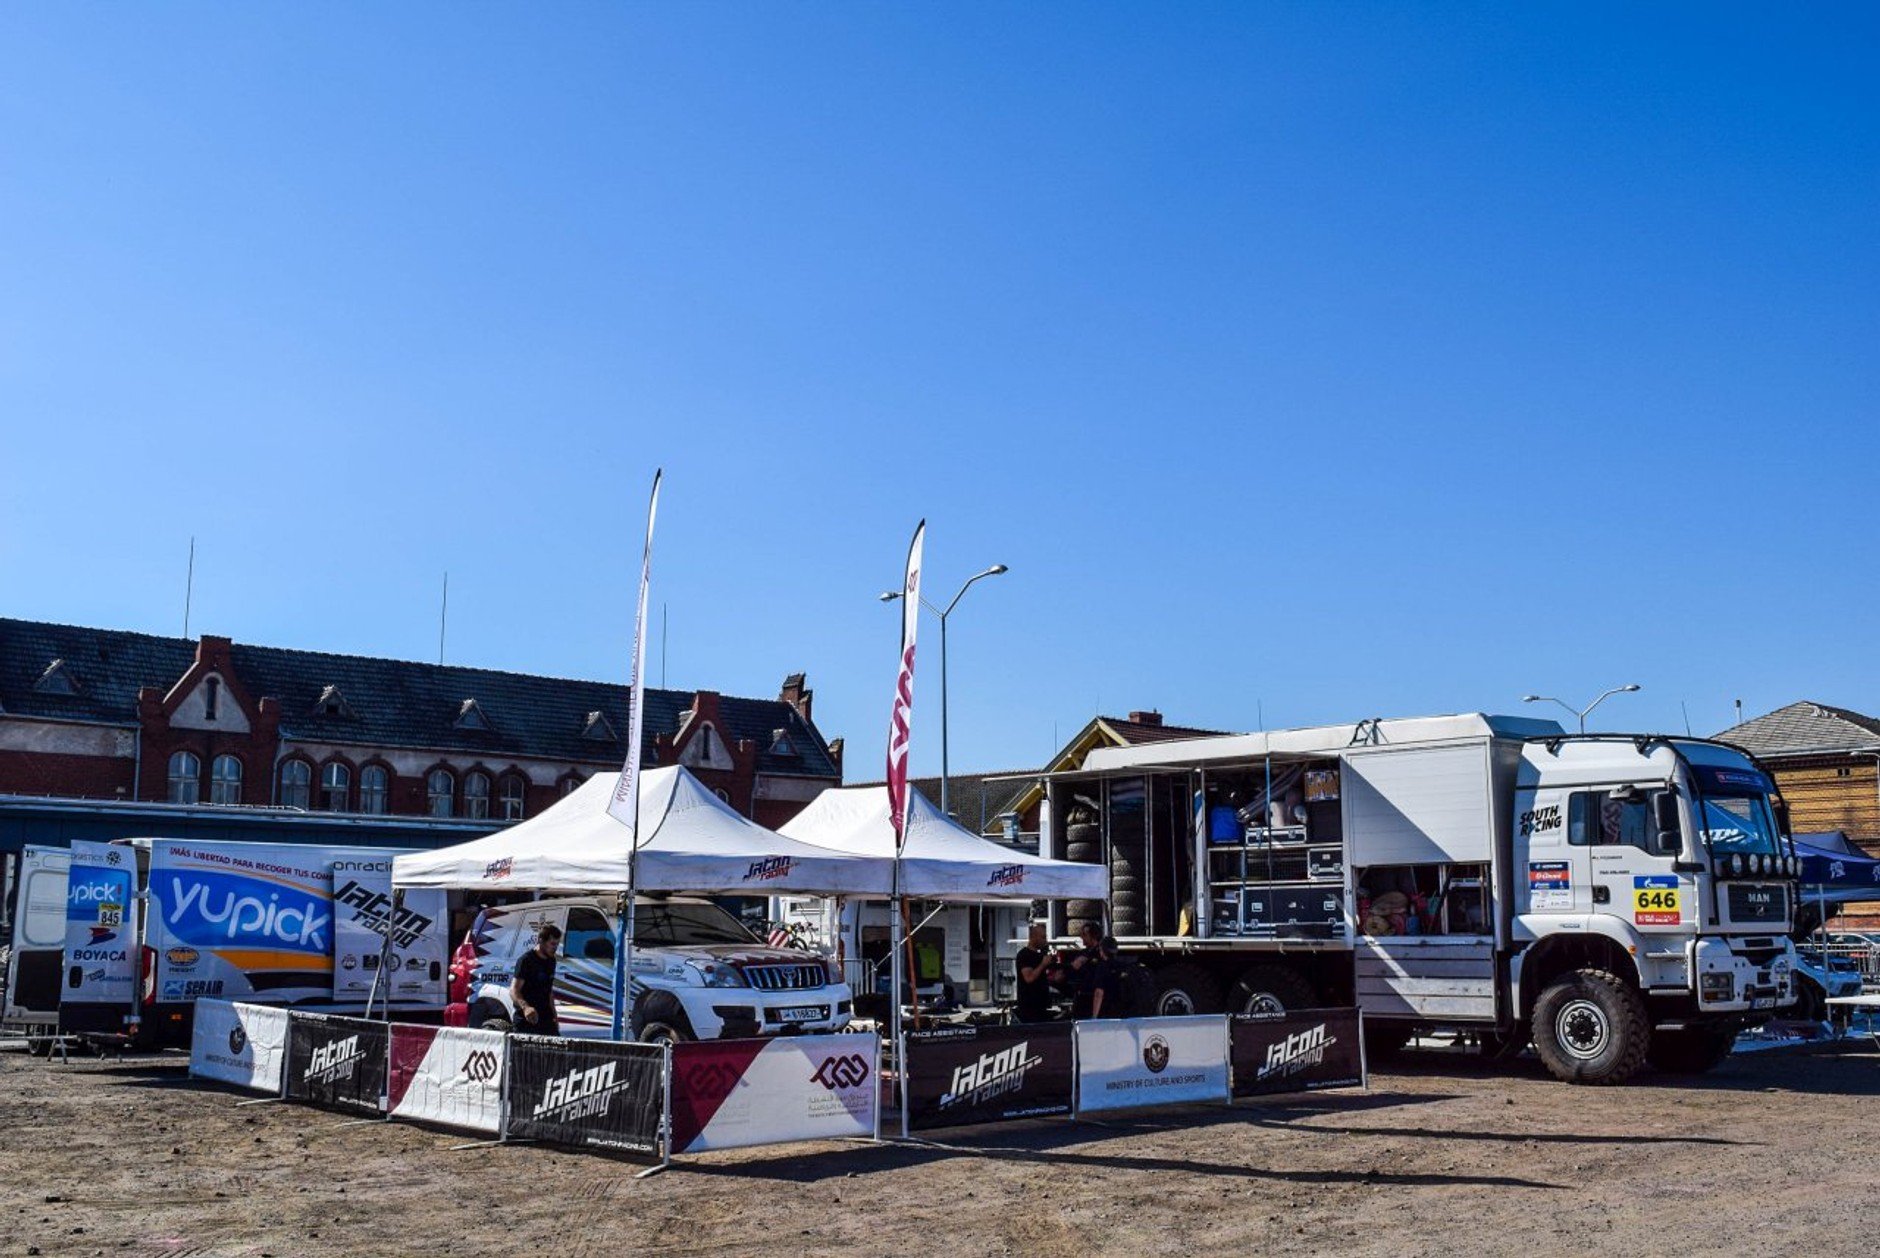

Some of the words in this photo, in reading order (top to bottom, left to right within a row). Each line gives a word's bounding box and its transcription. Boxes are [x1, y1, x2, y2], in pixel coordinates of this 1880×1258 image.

[1519, 804, 1560, 825] SOUTH
[194, 850, 230, 864] LIBERTAD
[233, 858, 254, 869] PARA
[256, 862, 292, 875] RECOGER
[294, 868, 309, 878] TUS
[333, 861, 392, 872] onraci
[1638, 892, 1676, 908] 646
[1748, 893, 1770, 903] MAN
[101, 911, 120, 925] 845
[73, 949, 126, 961] BOYACA
[481, 973, 509, 983] QATAR
[939, 1040, 1028, 1105] Jaton
[533, 1060, 617, 1116] Jaton
[972, 1066, 1025, 1107] racing
[1106, 1080, 1134, 1091] MINISTRY
[1184, 1074, 1206, 1084] SPORTS
[560, 1088, 613, 1124] racing
